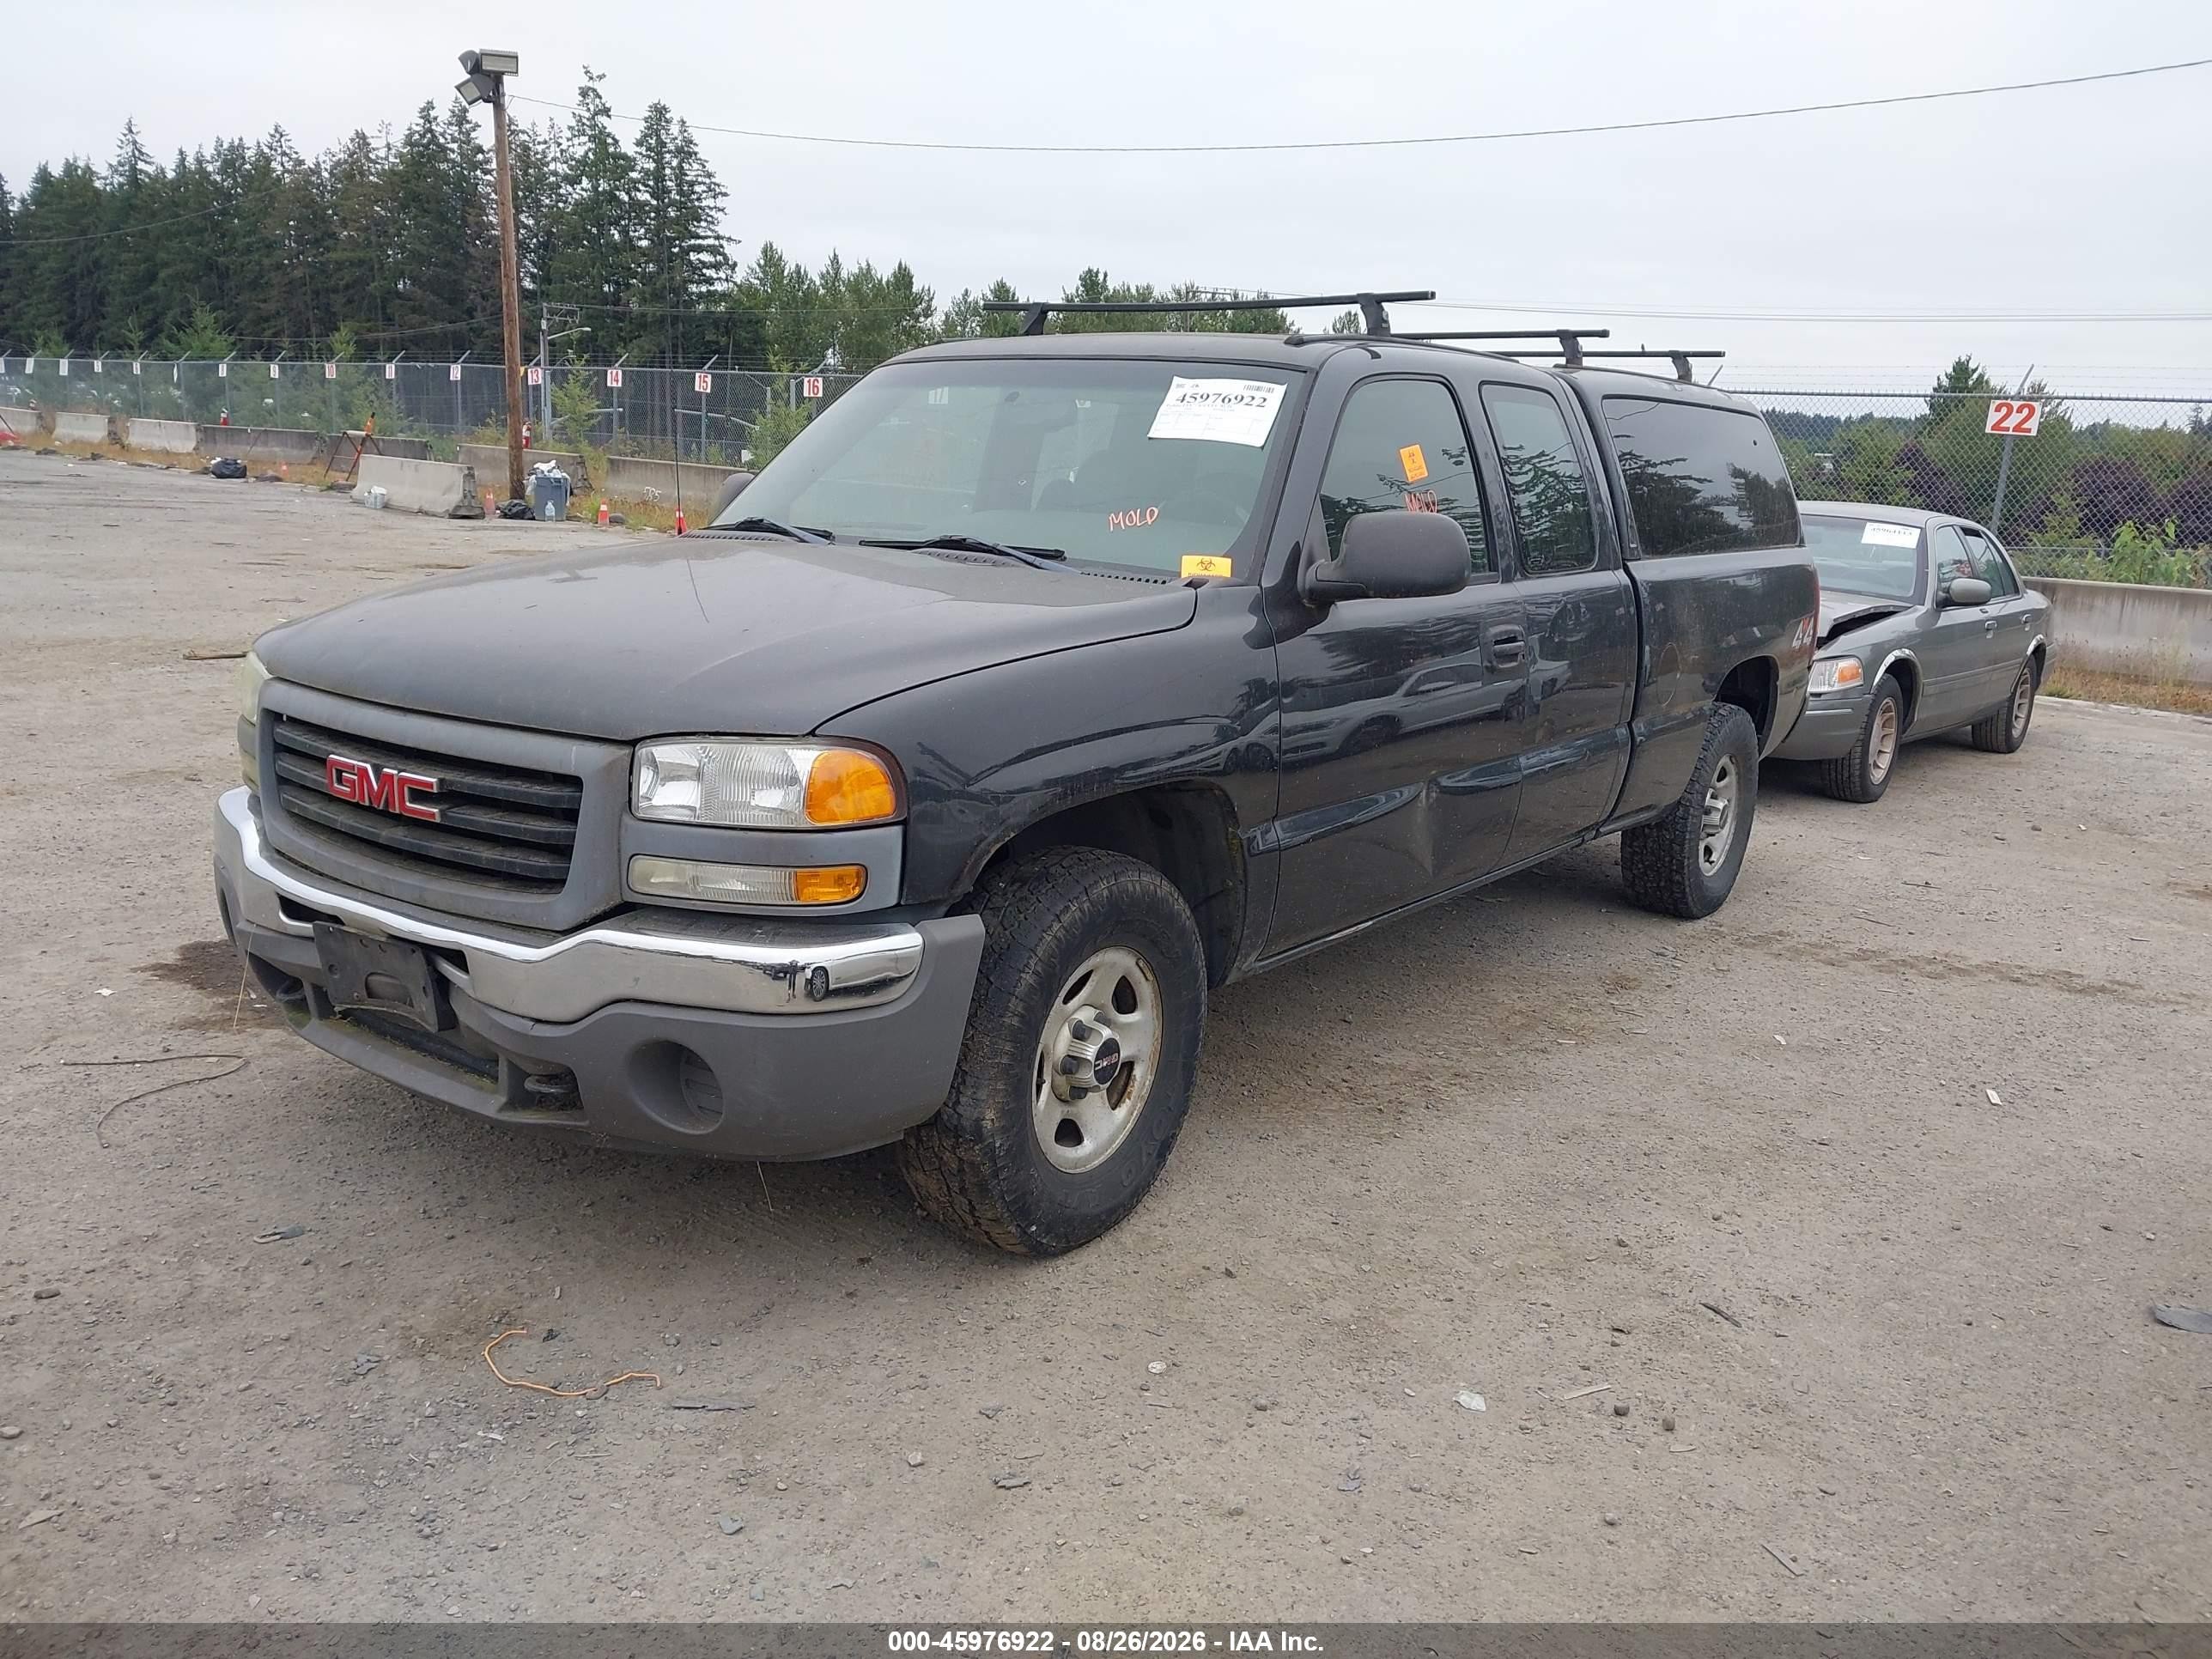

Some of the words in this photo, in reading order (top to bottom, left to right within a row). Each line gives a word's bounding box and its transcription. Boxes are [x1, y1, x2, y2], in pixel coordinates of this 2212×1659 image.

[327, 364, 334, 378] 10
[452, 365, 459, 380] 12
[530, 369, 539, 384] 13
[609, 370, 620, 386] 14
[697, 374, 709, 392] 15
[806, 379, 820, 397] 16
[1176, 392, 1268, 409] 45976922
[1990, 402, 2036, 434] 22
[1108, 506, 1159, 532] MOLD
[325, 753, 441, 823] GMC
